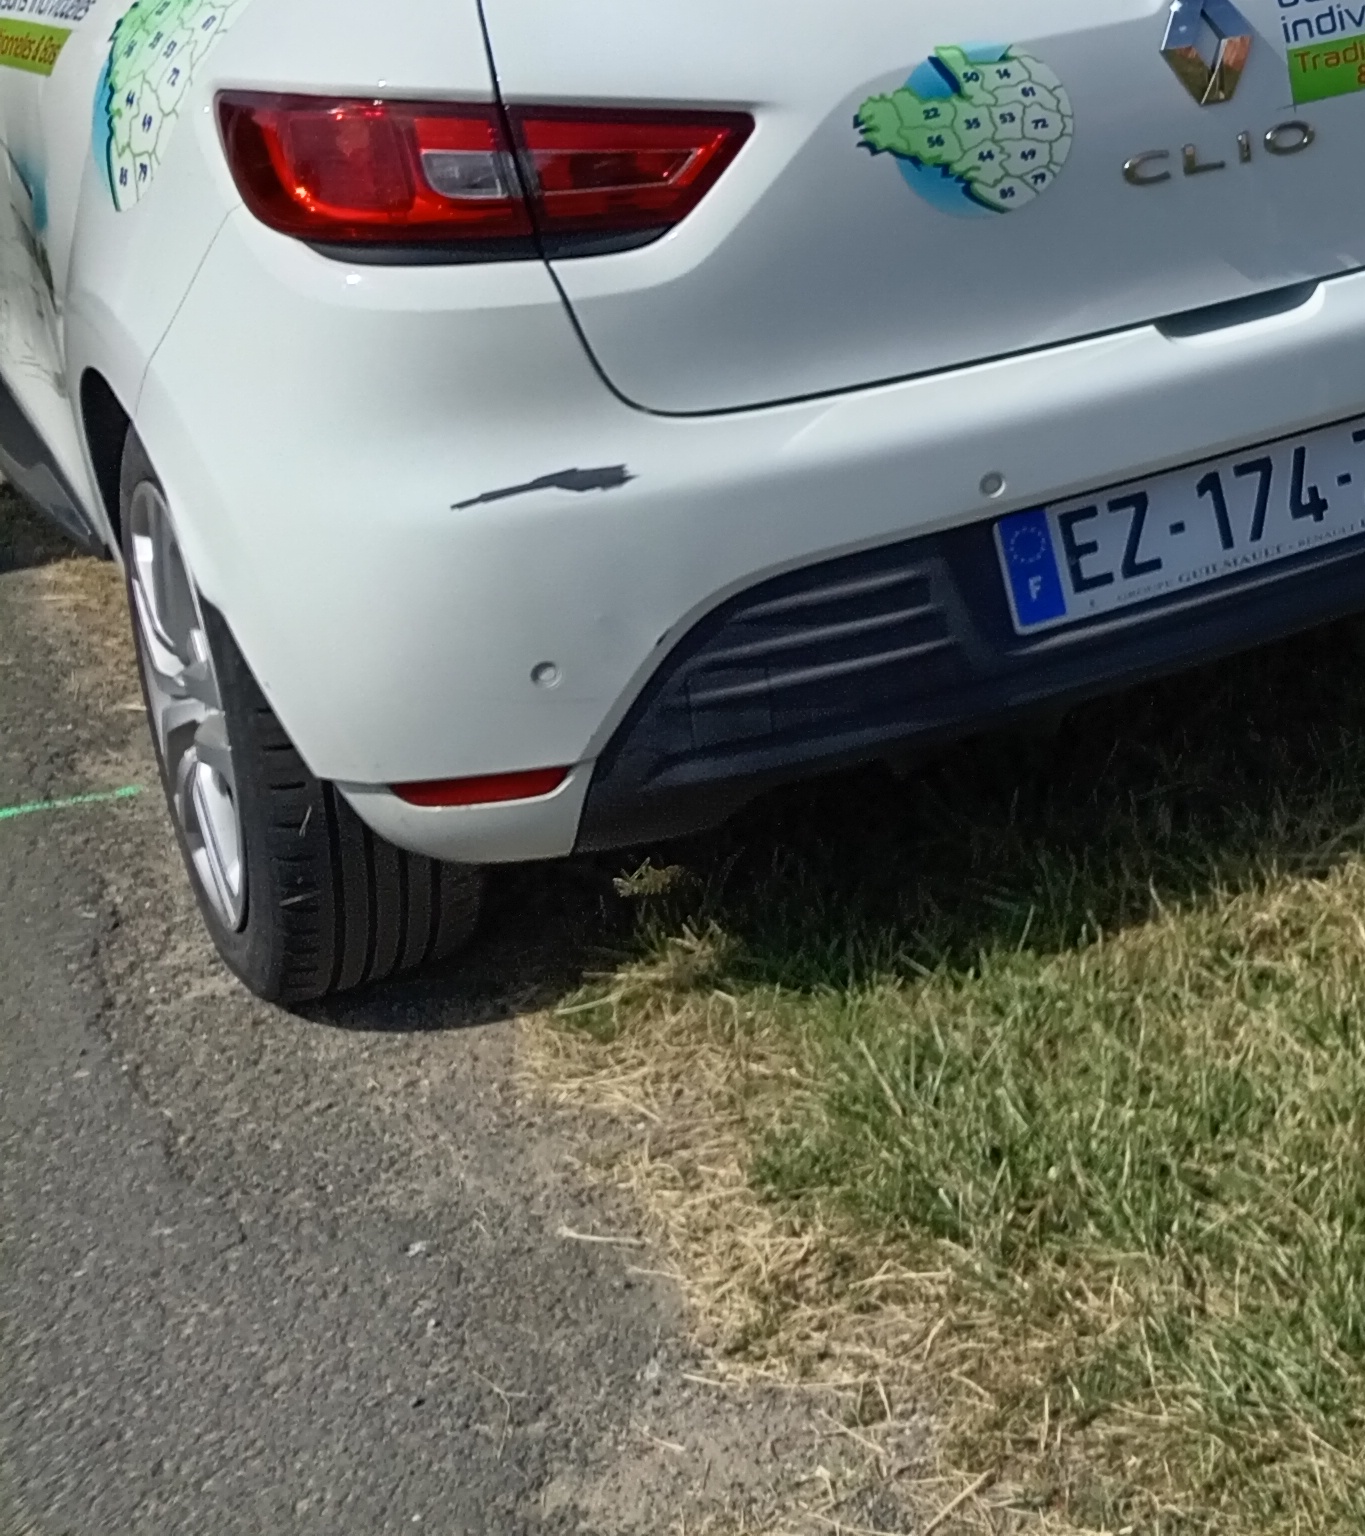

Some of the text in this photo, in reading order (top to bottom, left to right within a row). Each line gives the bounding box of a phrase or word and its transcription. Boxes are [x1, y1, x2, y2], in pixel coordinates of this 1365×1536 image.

[962, 71, 980, 83] 50
[923, 107, 941, 120] 22
[999, 112, 1016, 124] 53
[964, 118, 981, 130] 35
[1032, 118, 1049, 130] 72
[927, 135, 945, 148] 56
[978, 149, 994, 162] 44
[1020, 149, 1036, 161] 49
[1122, 120, 1315, 185] CLIO
[1031, 172, 1047, 185] 79
[999, 186, 1015, 199] 85
[1029, 575, 1042, 600] F
